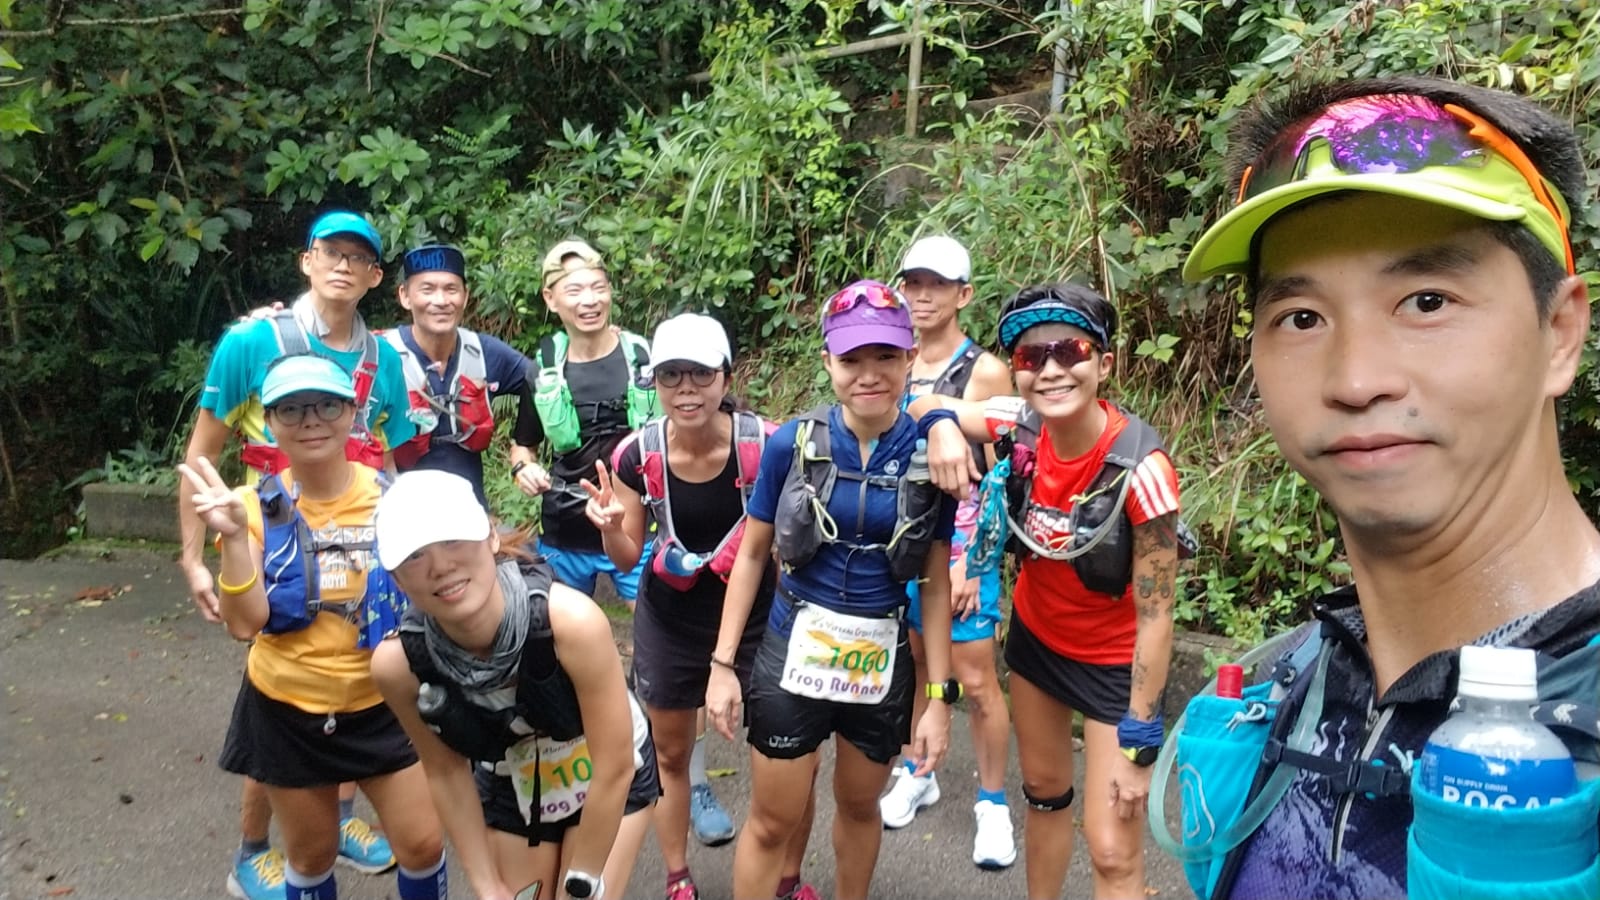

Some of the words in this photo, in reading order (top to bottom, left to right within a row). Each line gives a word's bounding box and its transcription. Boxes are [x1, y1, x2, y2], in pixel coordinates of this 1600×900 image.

[829, 647, 890, 675] 1060
[788, 668, 824, 692] Frog
[830, 676, 884, 695] Runner
[1457, 777, 1484, 789] SUPPLY
[1484, 783, 1508, 793] DRINK
